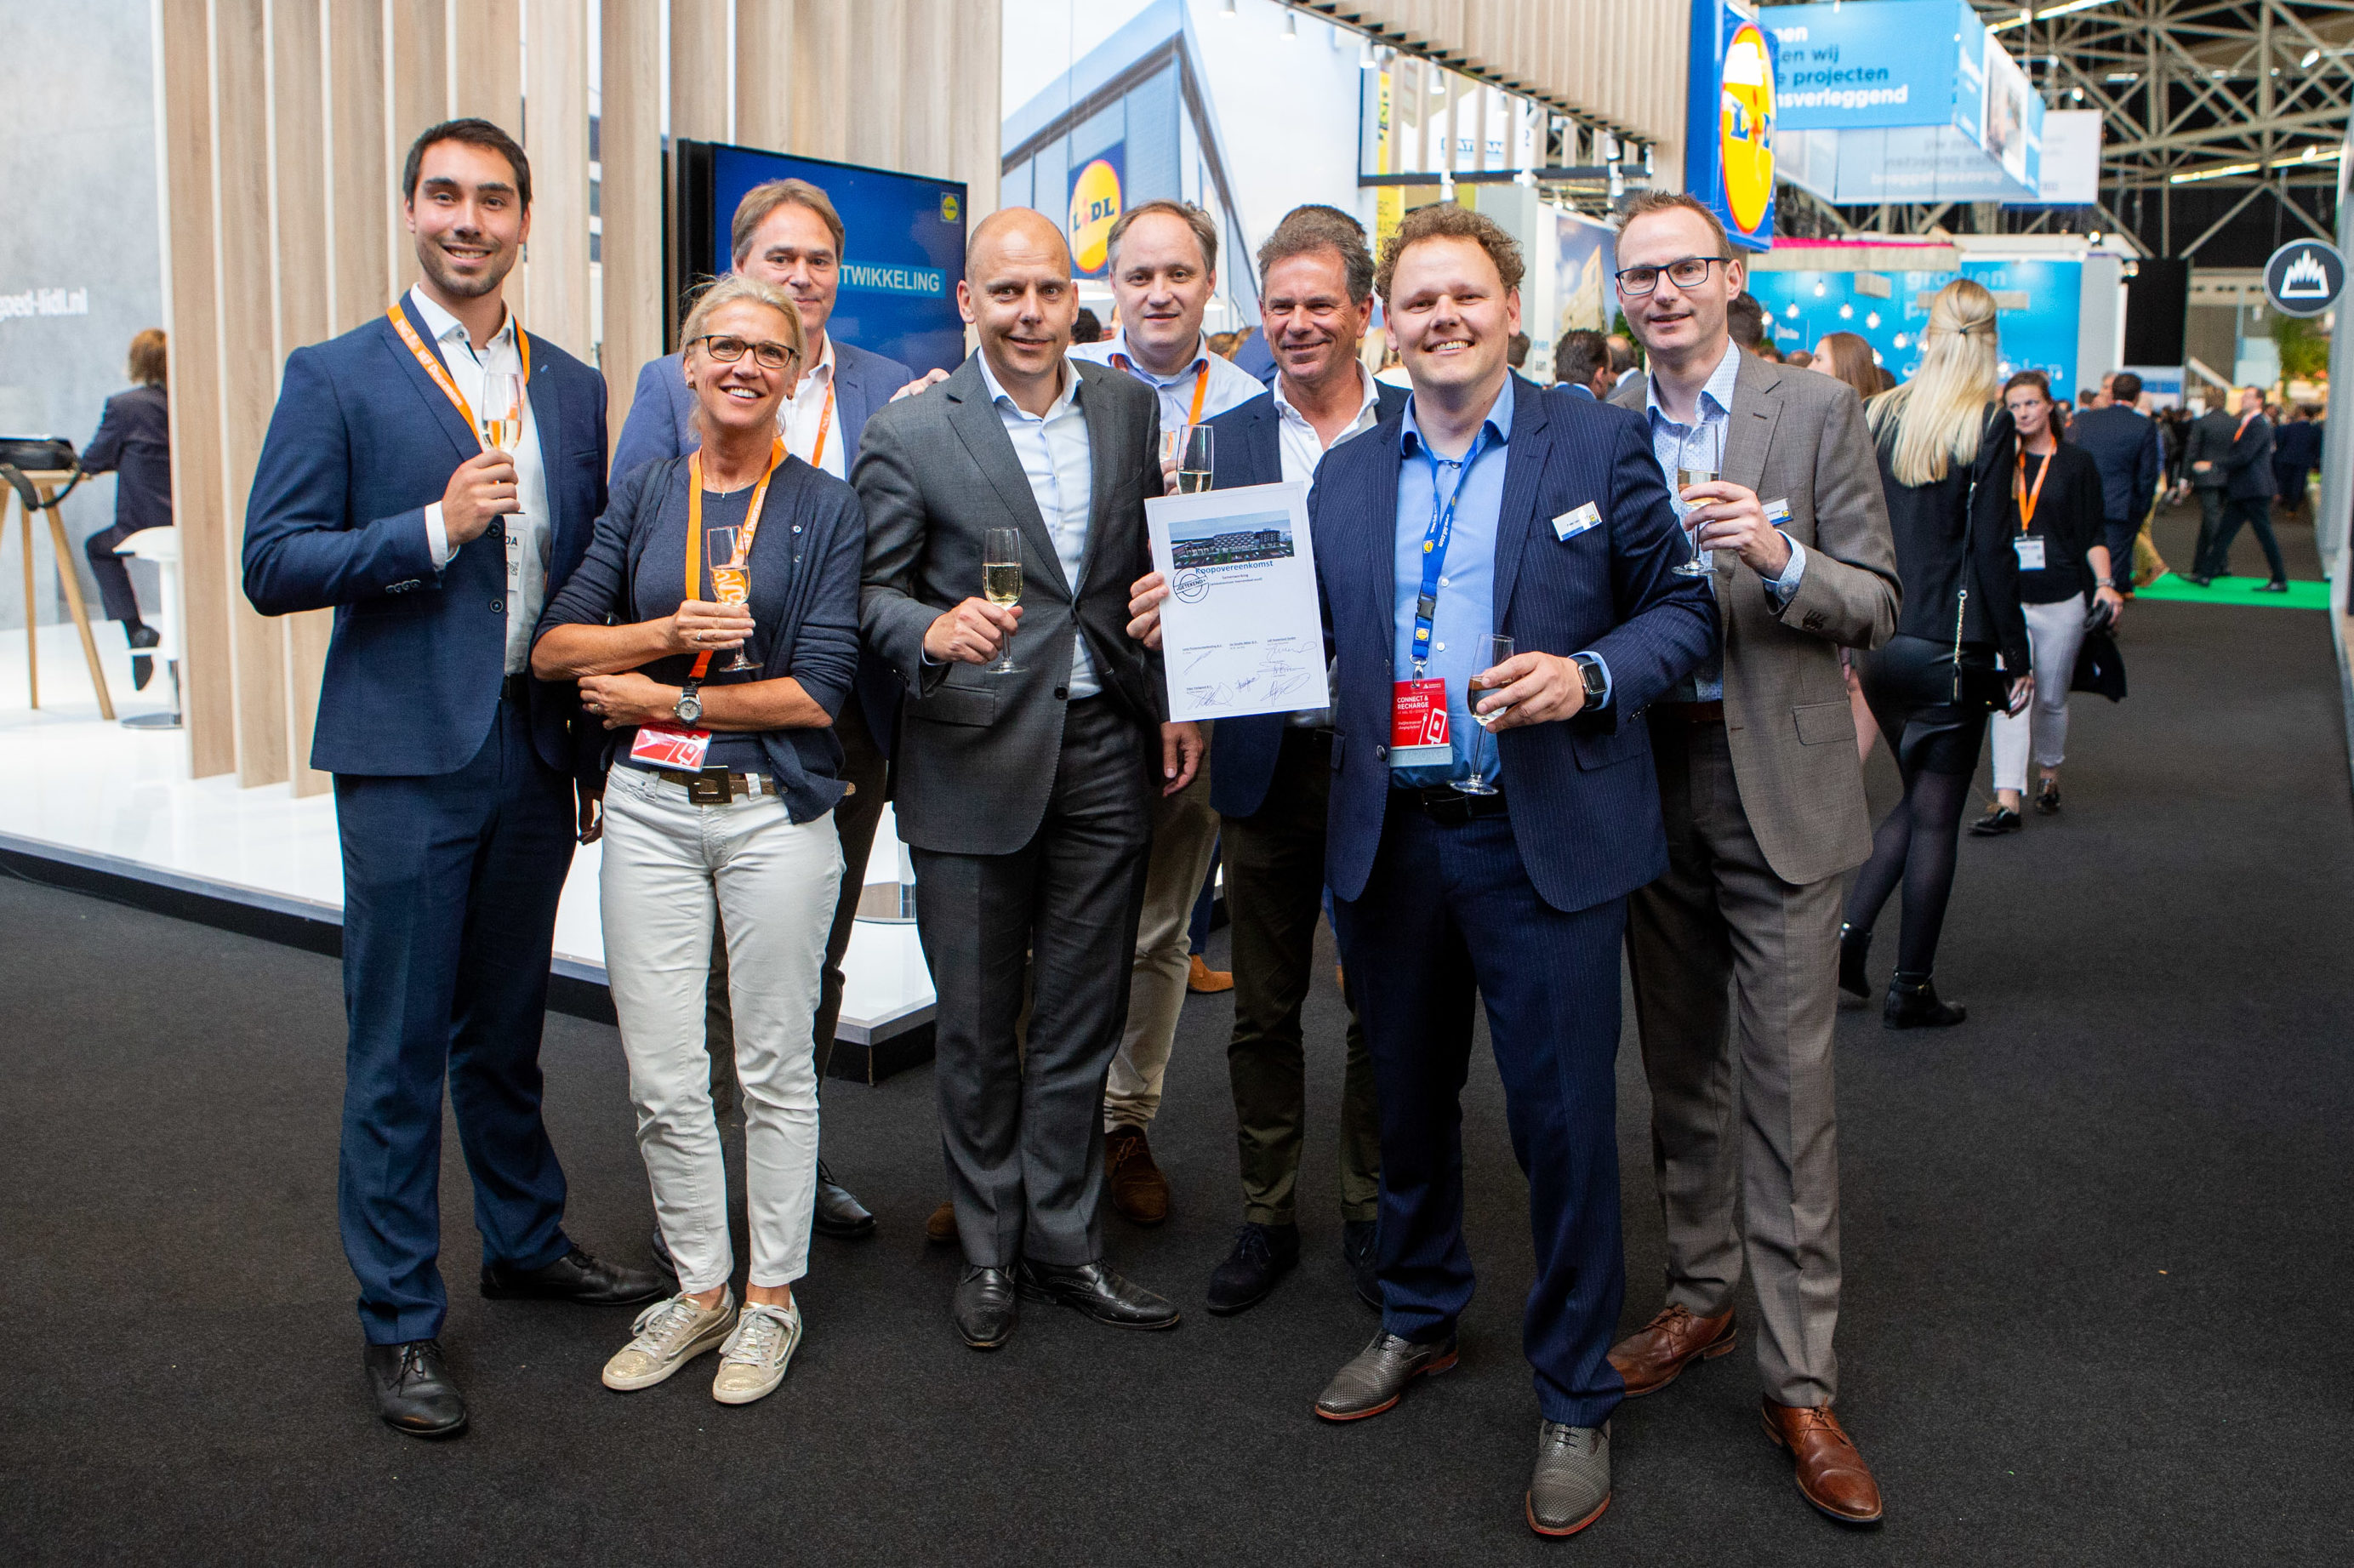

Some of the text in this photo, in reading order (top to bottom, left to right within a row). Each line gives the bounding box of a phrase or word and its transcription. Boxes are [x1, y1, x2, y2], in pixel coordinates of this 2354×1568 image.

[1813, 44, 1838, 64] wij
[1793, 66, 1889, 86] projecten
[837, 265, 939, 292] TWIKKELING
[1195, 561, 1274, 574] Koopovereenkomst
[1178, 579, 1204, 590] GETEKEND
